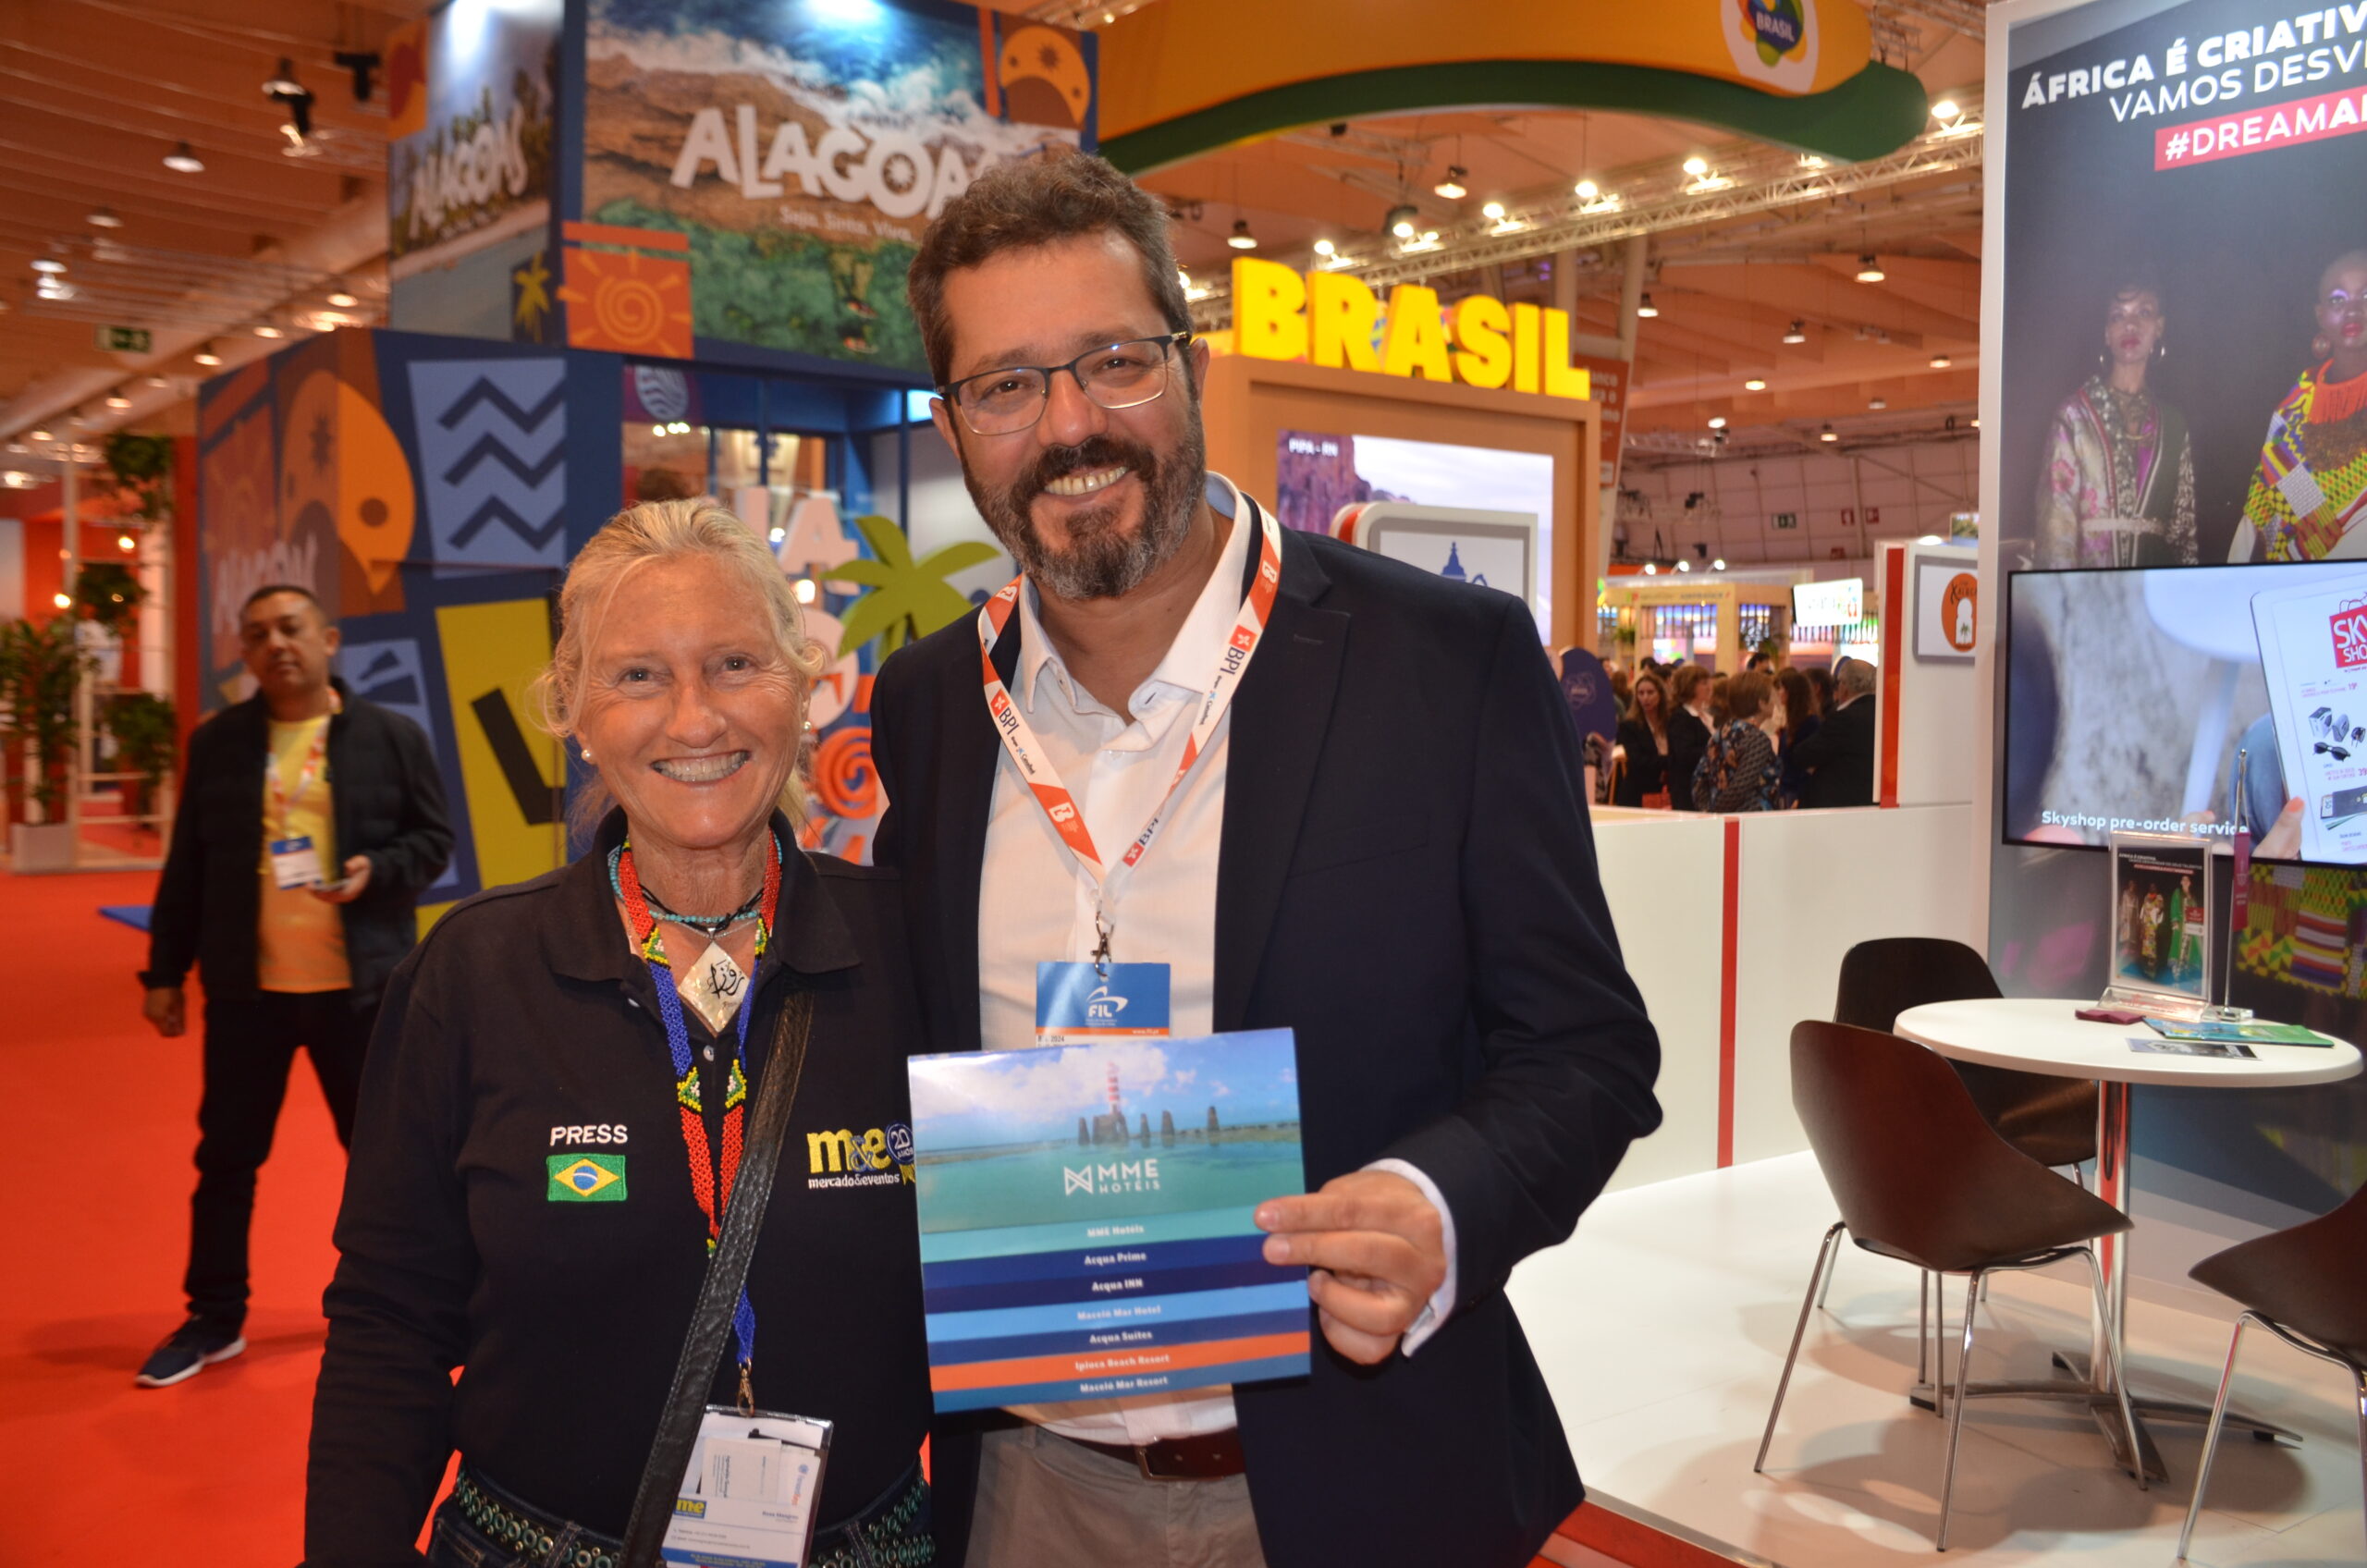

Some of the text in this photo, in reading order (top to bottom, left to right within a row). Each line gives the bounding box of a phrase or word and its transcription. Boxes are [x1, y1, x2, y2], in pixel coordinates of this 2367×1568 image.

[1756, 10, 1796, 43] BRASIL
[2021, 71, 2155, 109] ÁFRICA
[2166, 37, 2188, 77] É
[2109, 39, 2367, 123] VAMOS DESV
[669, 104, 999, 220] ALAGOA
[1232, 256, 1590, 401] BRASIL
[1220, 647, 1245, 676] BPI
[999, 706, 1020, 736] BPI
[2042, 810, 2106, 830] Skyshop
[2110, 817, 2186, 833] pre-order
[1088, 1004, 1113, 1018] FIL
[549, 1123, 629, 1147] PRESS
[890, 1128, 911, 1150] 20
[806, 1128, 892, 1173] m&e
[808, 1171, 900, 1190] mercado&eventos
[1098, 1158, 1159, 1182] MME
[1084, 1251, 1147, 1267] Acqua Prime
[1091, 1278, 1144, 1292] Acqua INN
[1113, 1307, 1132, 1317] Mar
[1134, 1304, 1162, 1316] Hotel
[1089, 1330, 1153, 1345] Acqua Suites
[1107, 1356, 1136, 1367] Beach
[1137, 1353, 1170, 1366] Resort
[1115, 1379, 1134, 1390] Mar
[1135, 1375, 1168, 1389] Resort
